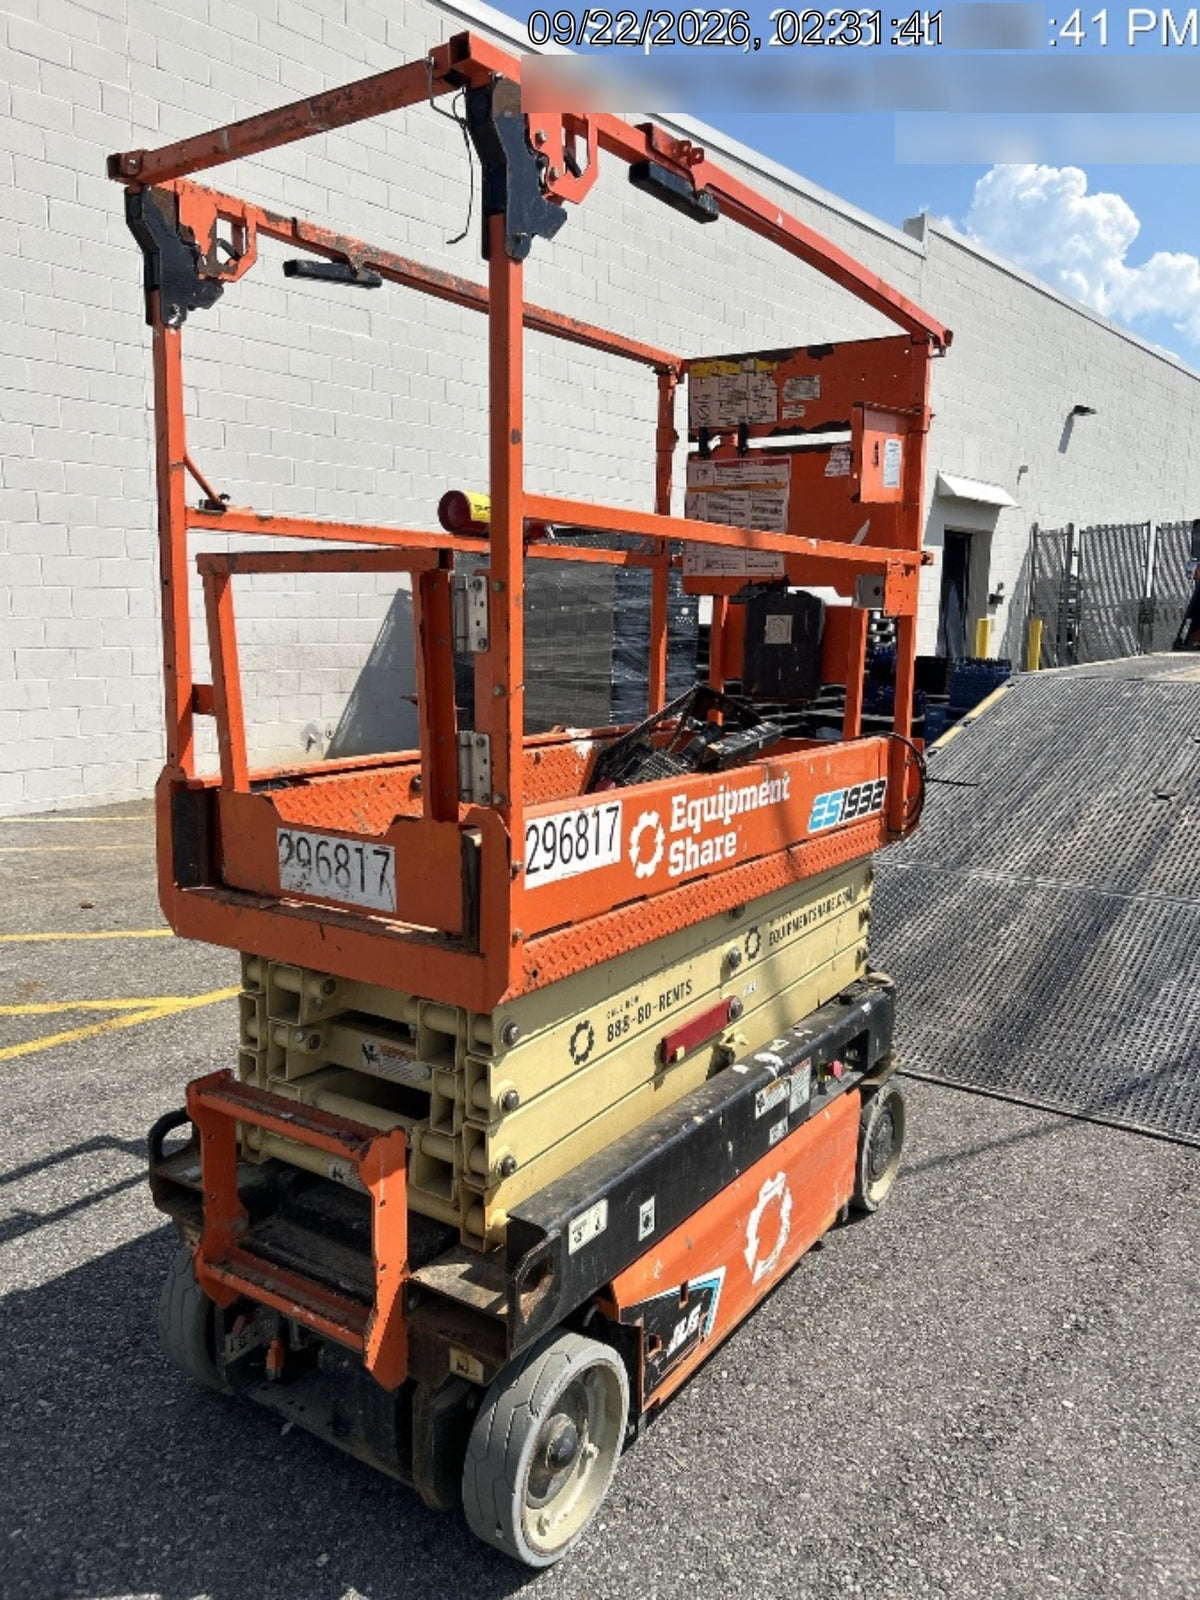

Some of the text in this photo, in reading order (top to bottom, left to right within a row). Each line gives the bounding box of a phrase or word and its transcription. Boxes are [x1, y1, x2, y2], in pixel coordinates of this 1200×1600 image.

[670, 775, 791, 835] Equipment
[278, 832, 391, 897] 296817
[525, 805, 620, 876] 296817
[667, 830, 737, 877] Share
